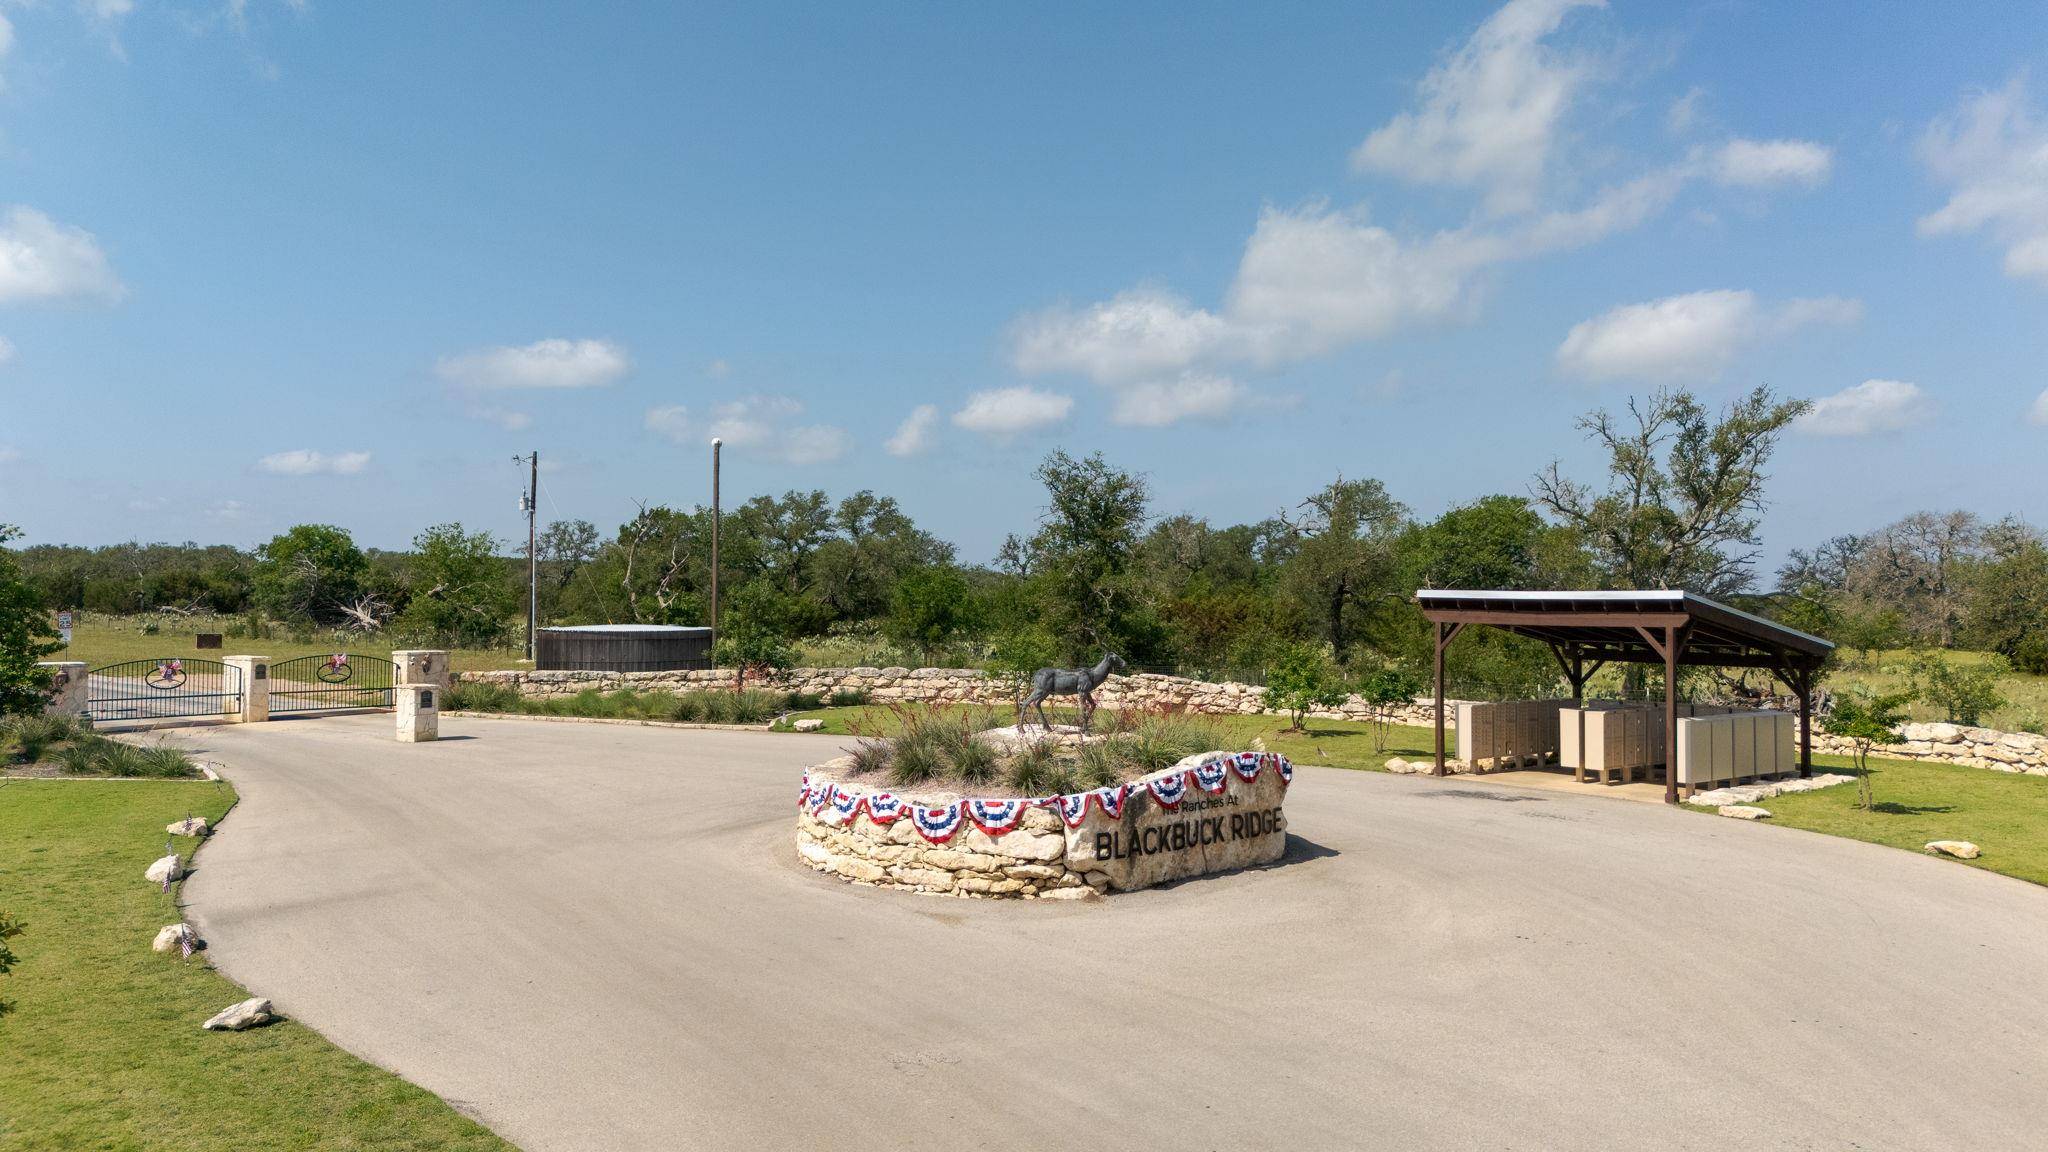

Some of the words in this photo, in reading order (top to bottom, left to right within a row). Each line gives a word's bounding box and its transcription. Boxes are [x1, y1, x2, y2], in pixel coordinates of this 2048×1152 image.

[1181, 796, 1224, 813] Ranches
[1226, 795, 1238, 806] At
[1096, 815, 1225, 861] BLACKBUCK
[1231, 807, 1283, 841] RIDGE
